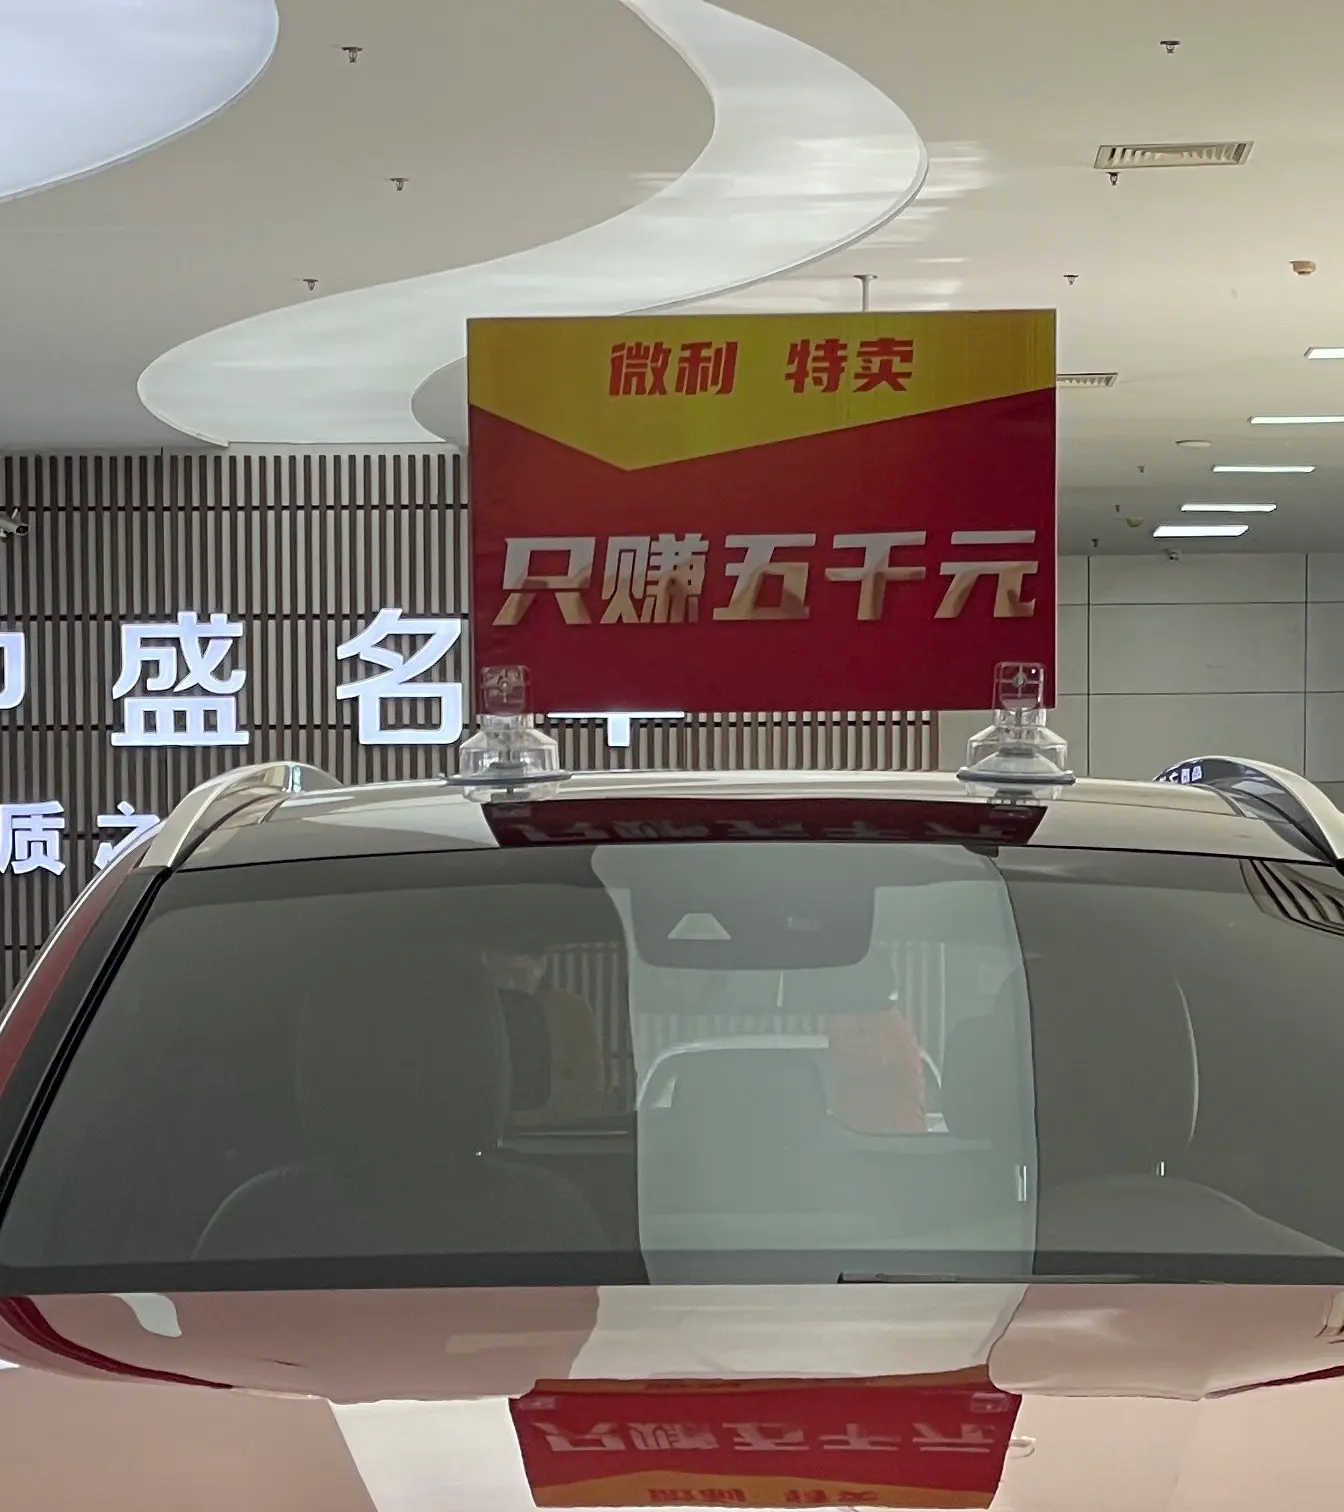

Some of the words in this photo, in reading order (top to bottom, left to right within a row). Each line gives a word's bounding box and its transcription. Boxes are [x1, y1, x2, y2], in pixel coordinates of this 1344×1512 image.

[608, 340, 739, 396] 微利
[784, 337, 915, 394] 特卖
[492, 529, 1040, 626] 只赚五千元
